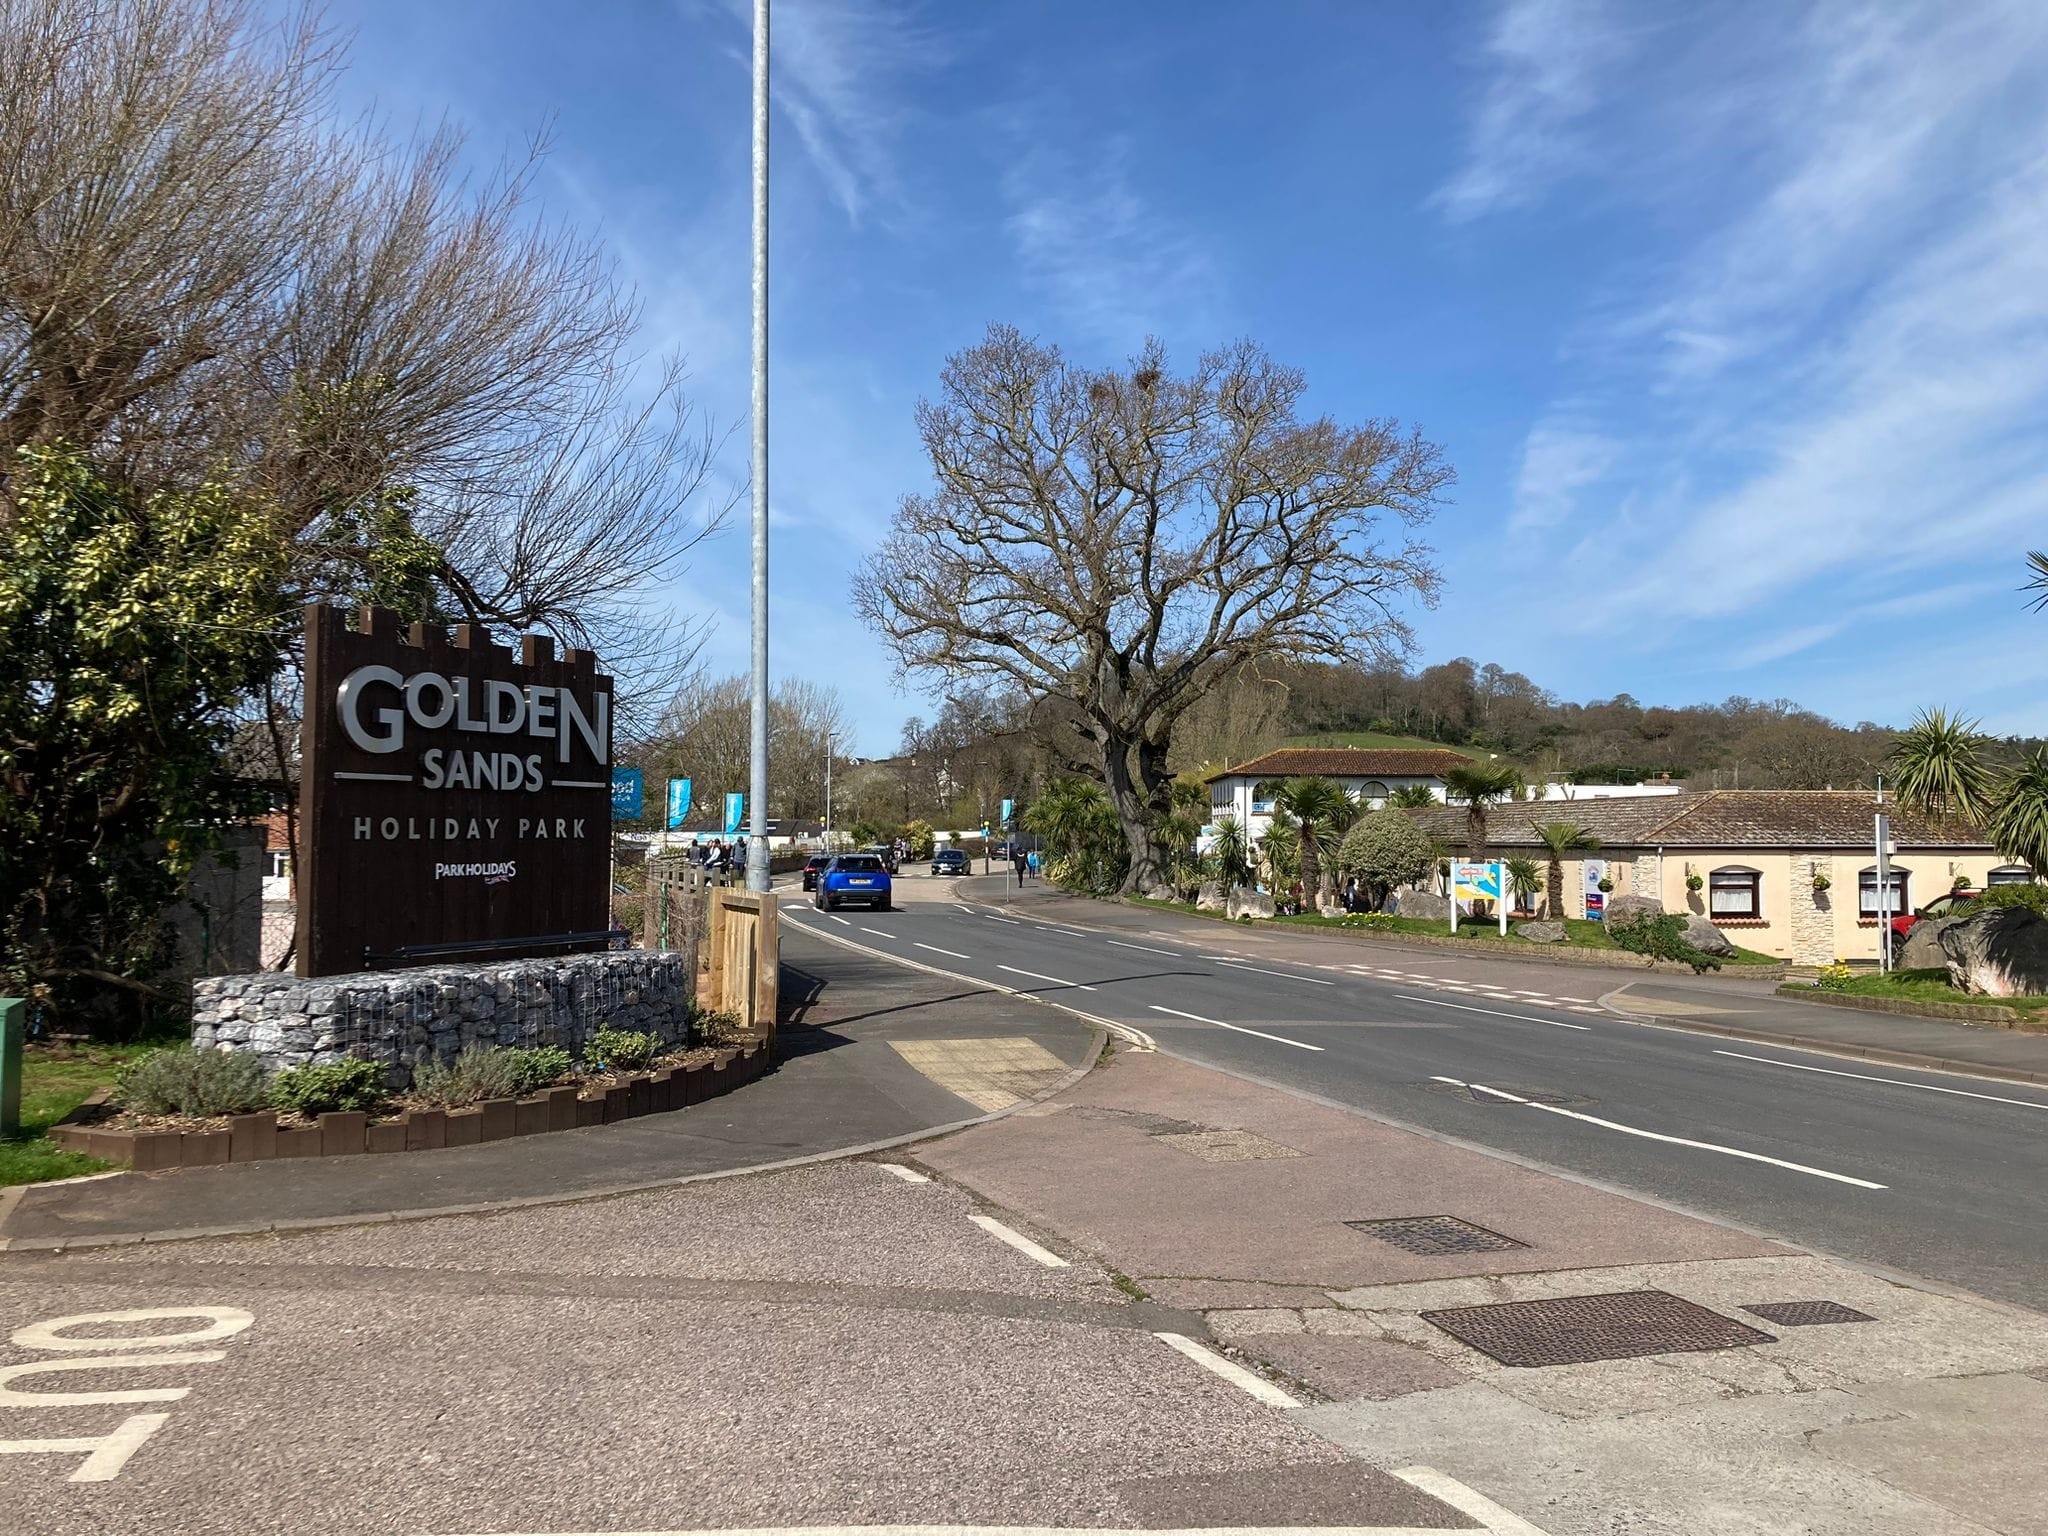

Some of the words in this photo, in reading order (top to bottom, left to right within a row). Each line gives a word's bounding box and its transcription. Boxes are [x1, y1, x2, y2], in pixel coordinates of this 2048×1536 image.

[337, 665, 607, 765] GOLDEN
[423, 749, 544, 791] SANDS
[353, 816, 500, 841] HOLIDAY
[518, 818, 586, 839] PARK
